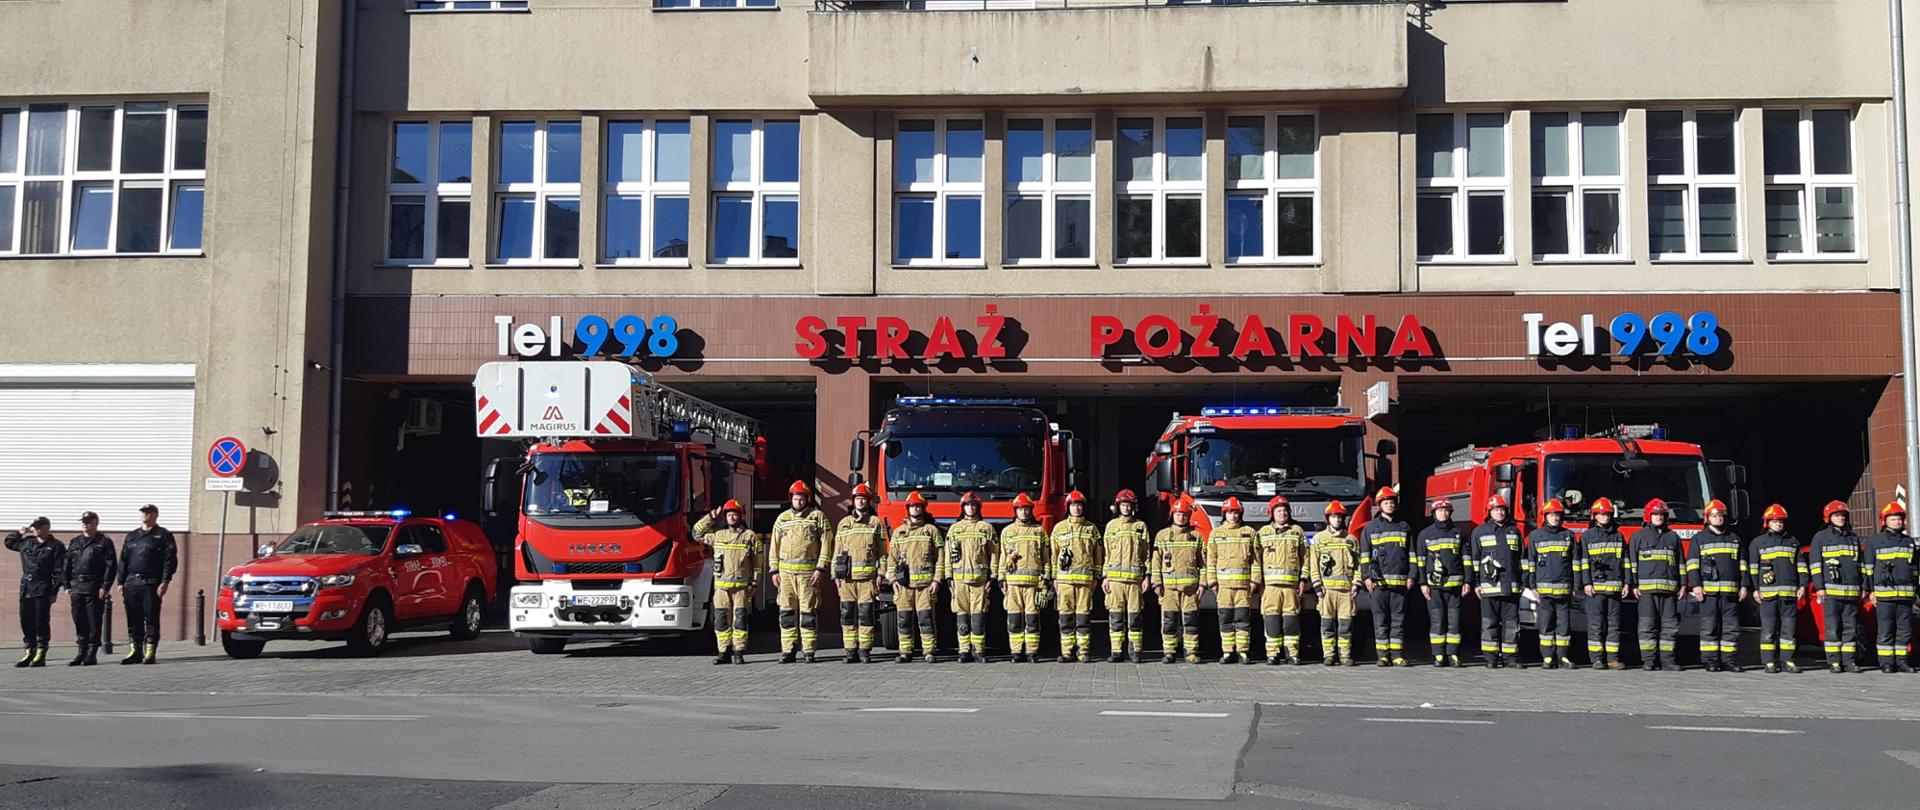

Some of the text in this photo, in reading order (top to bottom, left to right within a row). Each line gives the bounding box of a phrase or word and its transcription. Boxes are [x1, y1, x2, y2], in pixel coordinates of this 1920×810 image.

[494, 313, 678, 358] Tel 998
[795, 303, 1434, 359] STRAŻ POŻARNA
[1522, 311, 1720, 356] Tel 998
[530, 423, 577, 431] MAGIRUS
[1248, 505, 1310, 517] SCIA
[568, 543, 622, 554] IVECO
